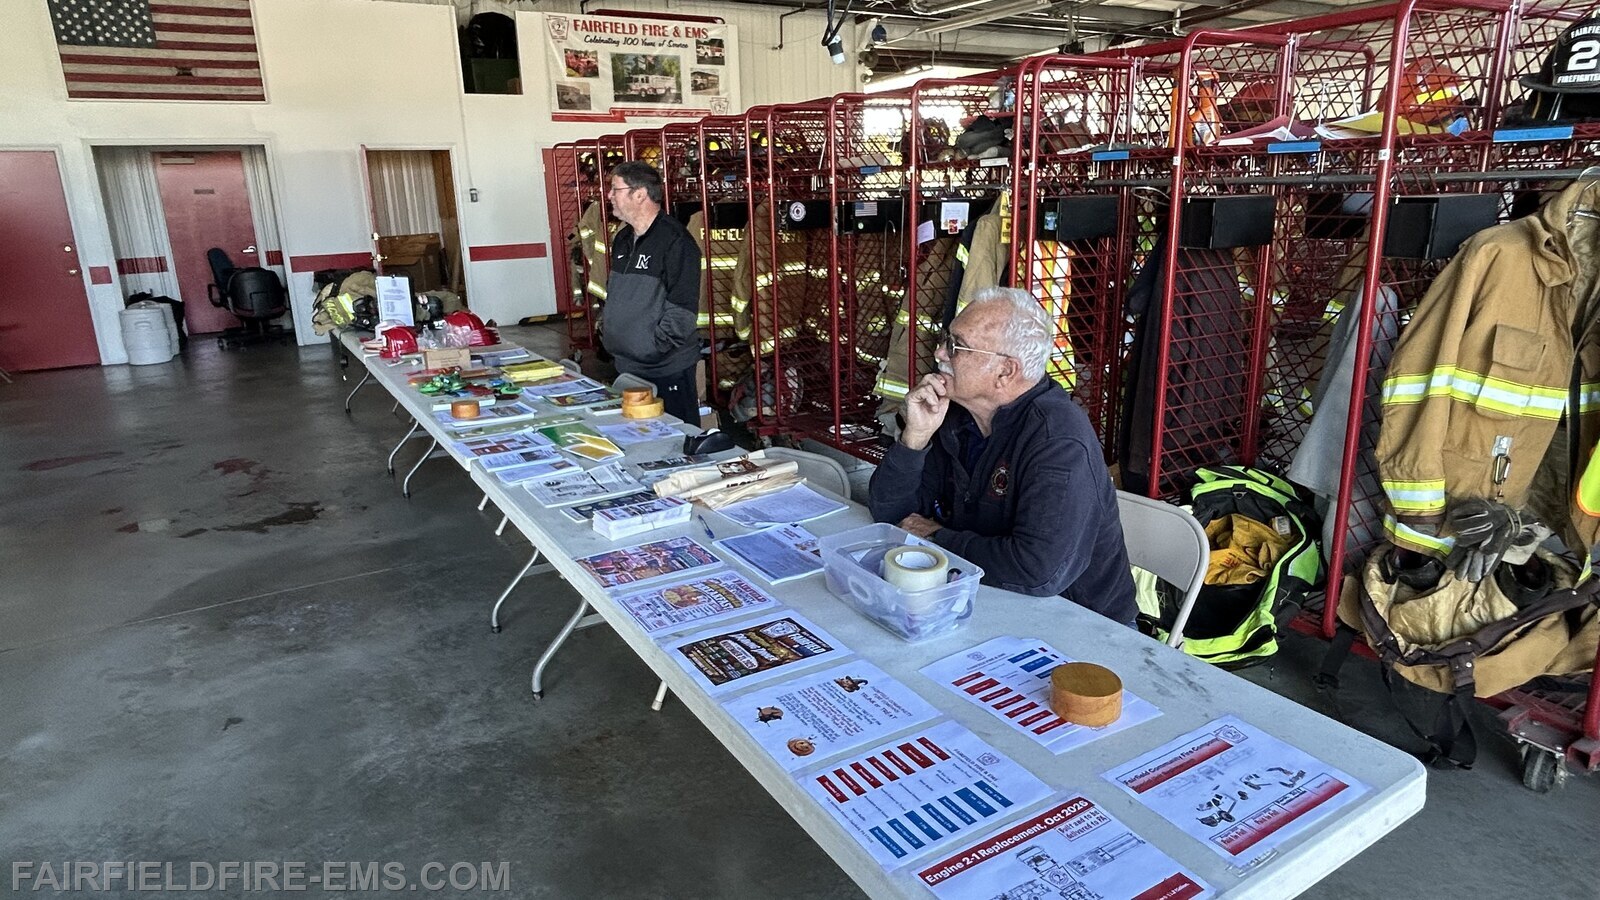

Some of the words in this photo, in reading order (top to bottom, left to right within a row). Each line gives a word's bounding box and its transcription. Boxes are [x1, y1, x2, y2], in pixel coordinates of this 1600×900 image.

[573, 19, 639, 35] FAIRFIELD
[641, 24, 669, 37] FIRE
[672, 26, 682, 38] &
[684, 26, 709, 39] EMS
[584, 35, 620, 47] Celebrating
[623, 37, 639, 46] 100
[641, 38, 656, 48] Years
[658, 39, 667, 48] of
[667, 39, 689, 49] Service
[1567, 40, 1600, 71] 2
[786, 632, 826, 654] FAIRFIELD
[1122, 769, 1151, 785] Fairfield
[1147, 754, 1184, 774] Community
[1179, 748, 1194, 757] Fire
[1055, 821, 1075, 833] Built
[1070, 816, 1085, 826] and
[1088, 808, 1100, 817] be
[1063, 821, 1092, 839] delivered
[1088, 818, 1099, 826] to
[1094, 814, 1107, 823] PA
[924, 859, 965, 884] Engine
[962, 851, 981, 867] 2-1
[980, 822, 1048, 860] Replacement,
[1045, 812, 1064, 826] Oct
[1062, 799, 1089, 820] 2026
